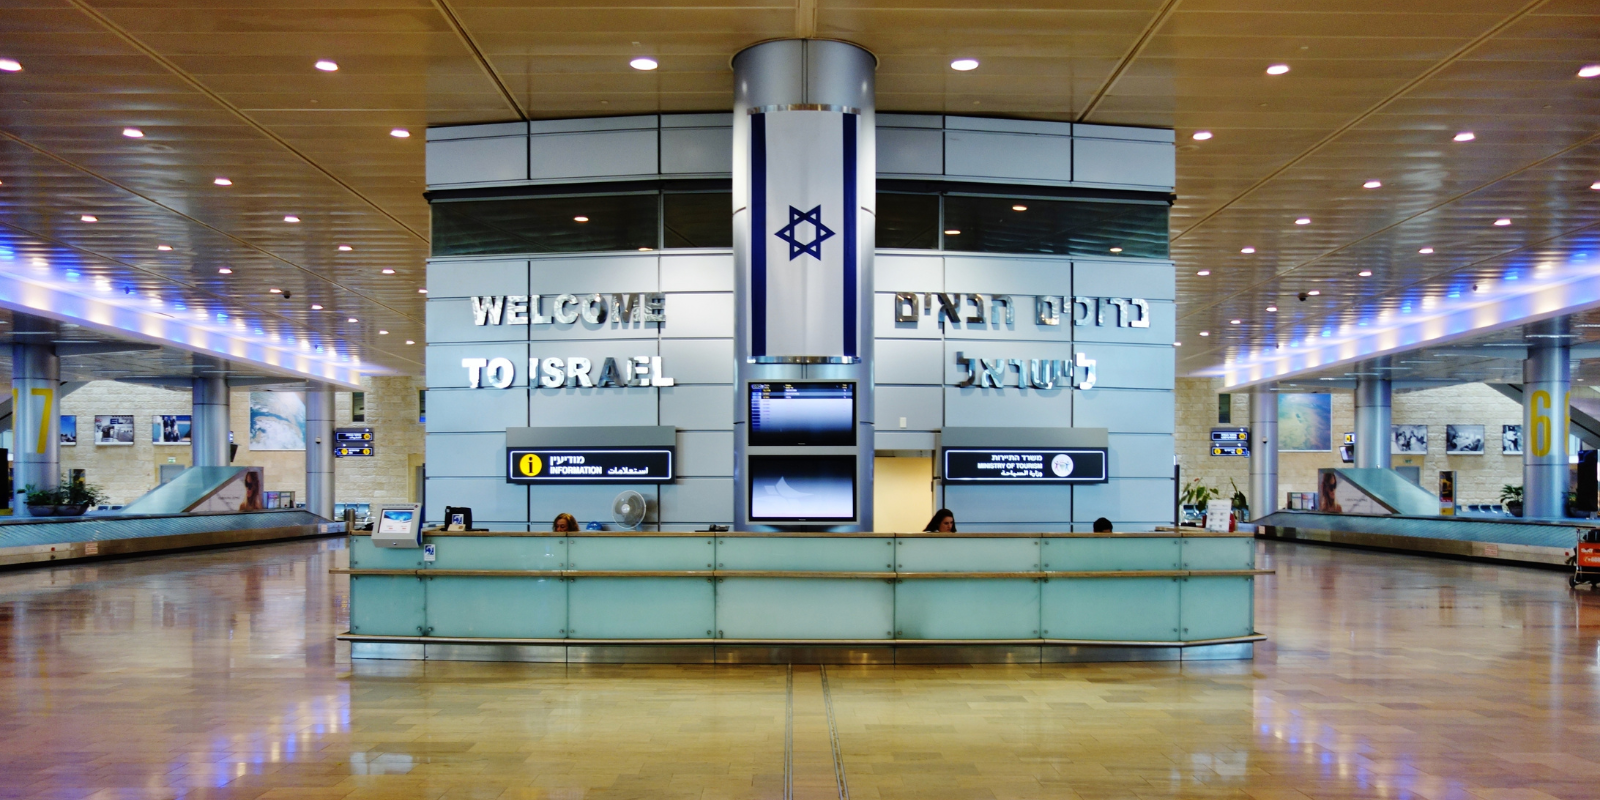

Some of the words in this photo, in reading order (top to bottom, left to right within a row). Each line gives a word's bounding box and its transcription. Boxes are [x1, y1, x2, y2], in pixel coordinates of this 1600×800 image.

[470, 292, 666, 326] WELCOME
[895, 292, 1015, 325] הבאים
[1035, 295, 1151, 328] ברוכים
[461, 357, 515, 389] TO
[529, 356, 674, 389] ISRAEL
[956, 351, 1097, 390] לישראל
[31, 388, 53, 454] 7
[1530, 389, 1551, 457] 6
[549, 455, 586, 467] מודיעין
[549, 466, 602, 475] INFORMATION
[607, 466, 649, 475] استعلامات
[991, 454, 1020, 462] התיירות
[1020, 454, 1043, 462] משרד
